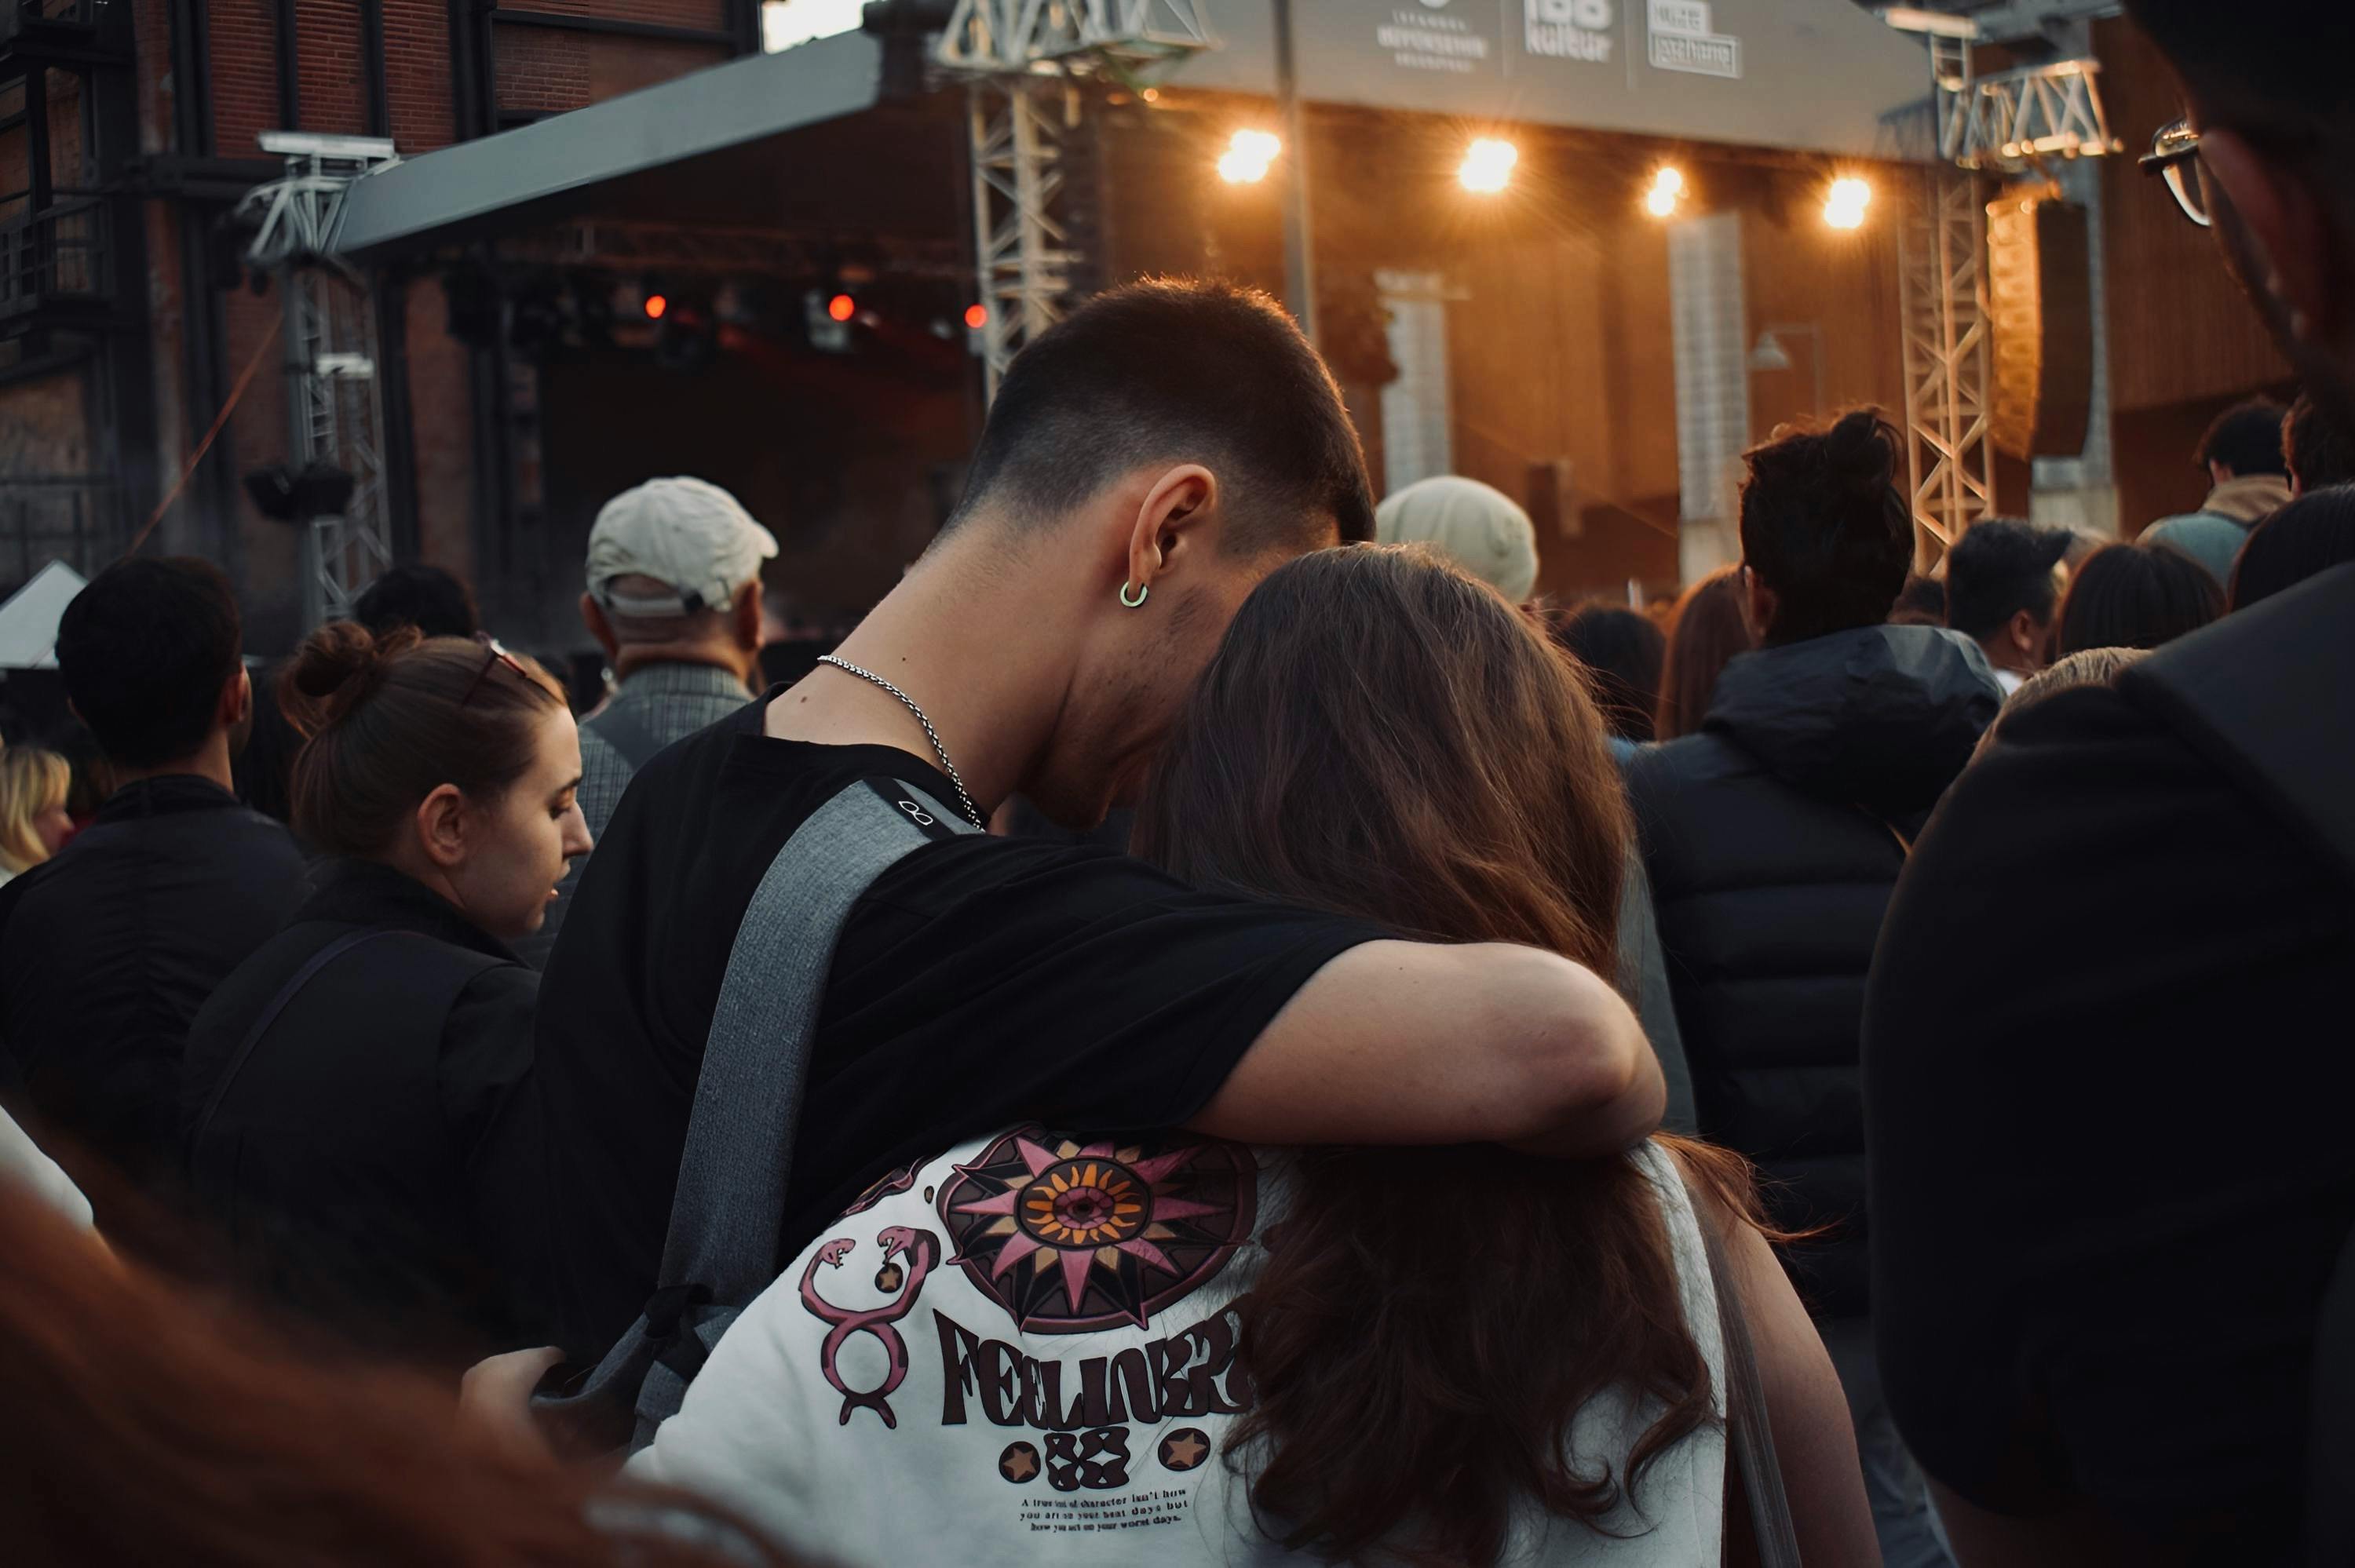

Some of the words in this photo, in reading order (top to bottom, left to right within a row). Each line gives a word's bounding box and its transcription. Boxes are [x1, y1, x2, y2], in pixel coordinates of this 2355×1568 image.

[1163, 1488, 1186, 1498] how
[1020, 1511, 1040, 1521] you
[1167, 1500, 1188, 1510] but
